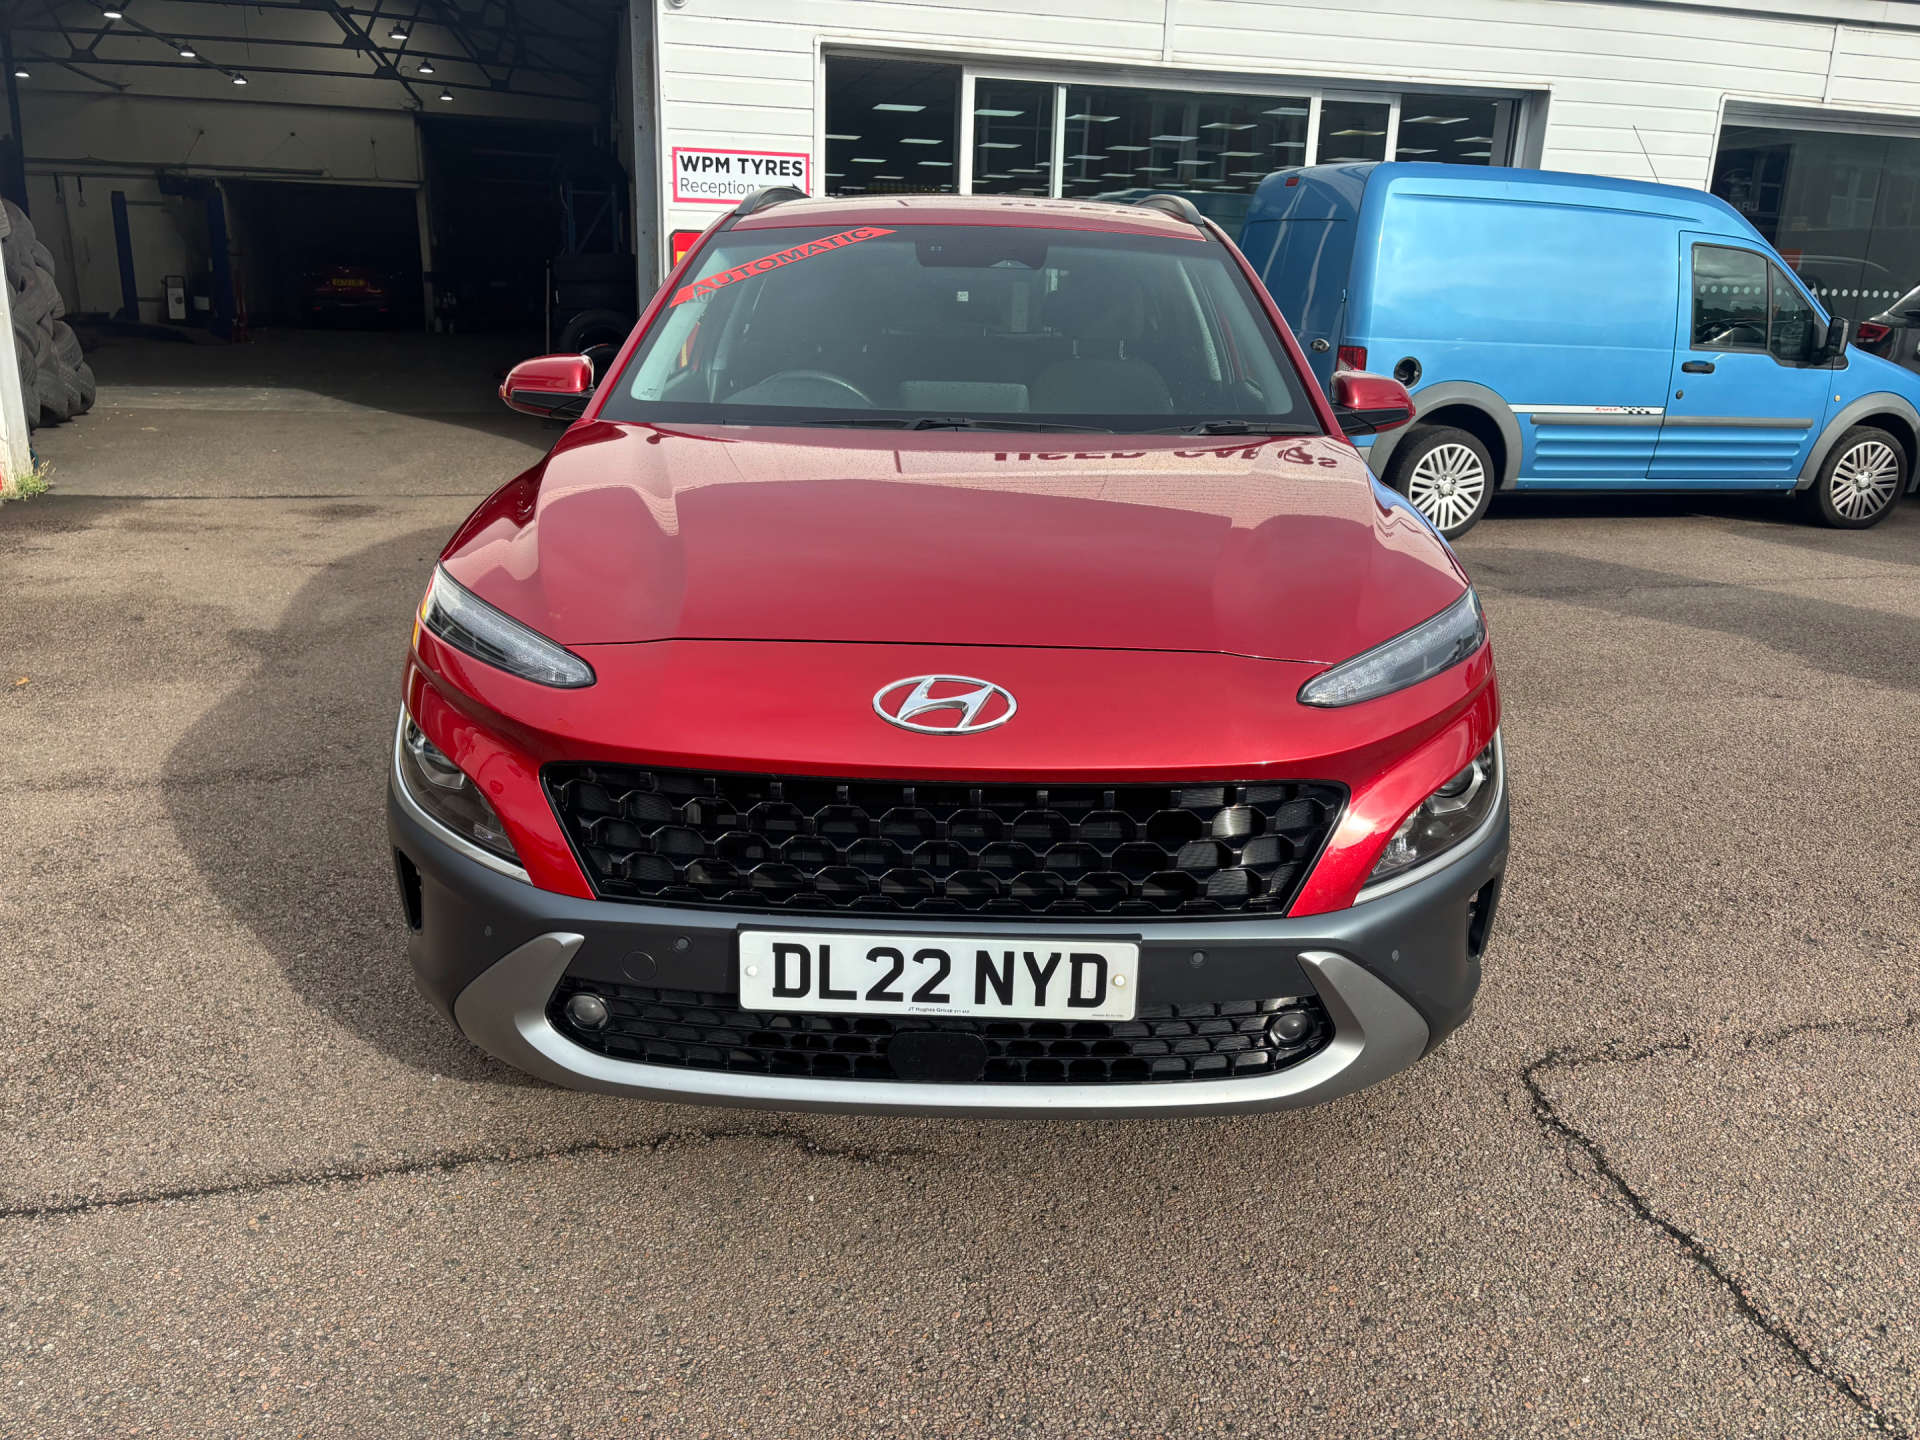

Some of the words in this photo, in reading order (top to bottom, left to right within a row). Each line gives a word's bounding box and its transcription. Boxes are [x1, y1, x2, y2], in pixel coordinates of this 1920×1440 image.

[680, 155, 730, 174] WPM
[737, 157, 803, 177] TYRES
[680, 178, 754, 197] Reception
[693, 229, 874, 297] AUTOMATIC
[772, 943, 951, 1004] DL22
[974, 950, 1108, 1008] NYD
